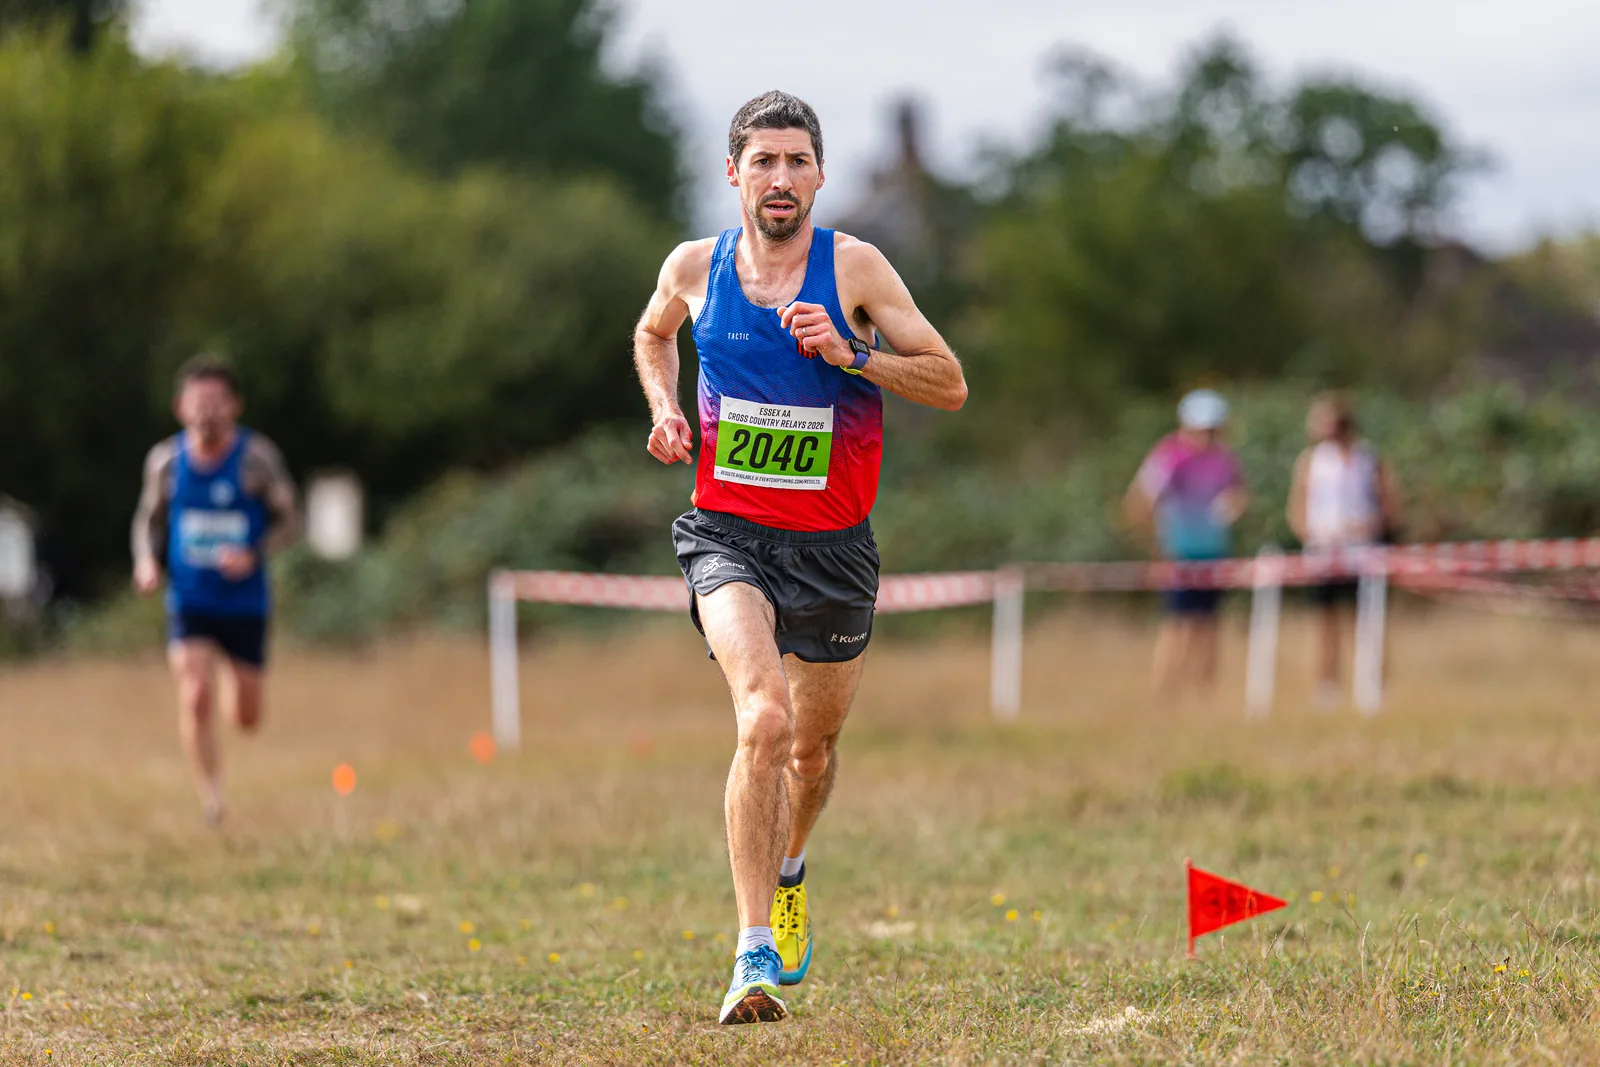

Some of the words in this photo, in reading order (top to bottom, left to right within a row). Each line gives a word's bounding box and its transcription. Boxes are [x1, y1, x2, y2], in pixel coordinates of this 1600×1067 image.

[727, 332, 750, 341] TACTIC
[759, 407, 781, 417] ESSEX
[781, 409, 791, 418] AA
[727, 411, 748, 423] CROSS
[749, 415, 780, 428] COUNTRY
[780, 419, 806, 430] RELAYS
[807, 421, 824, 430] 2026
[727, 428, 819, 473] 204C
[720, 469, 736, 478] RESULTS
[735, 472, 755, 481] AVAILABLE
